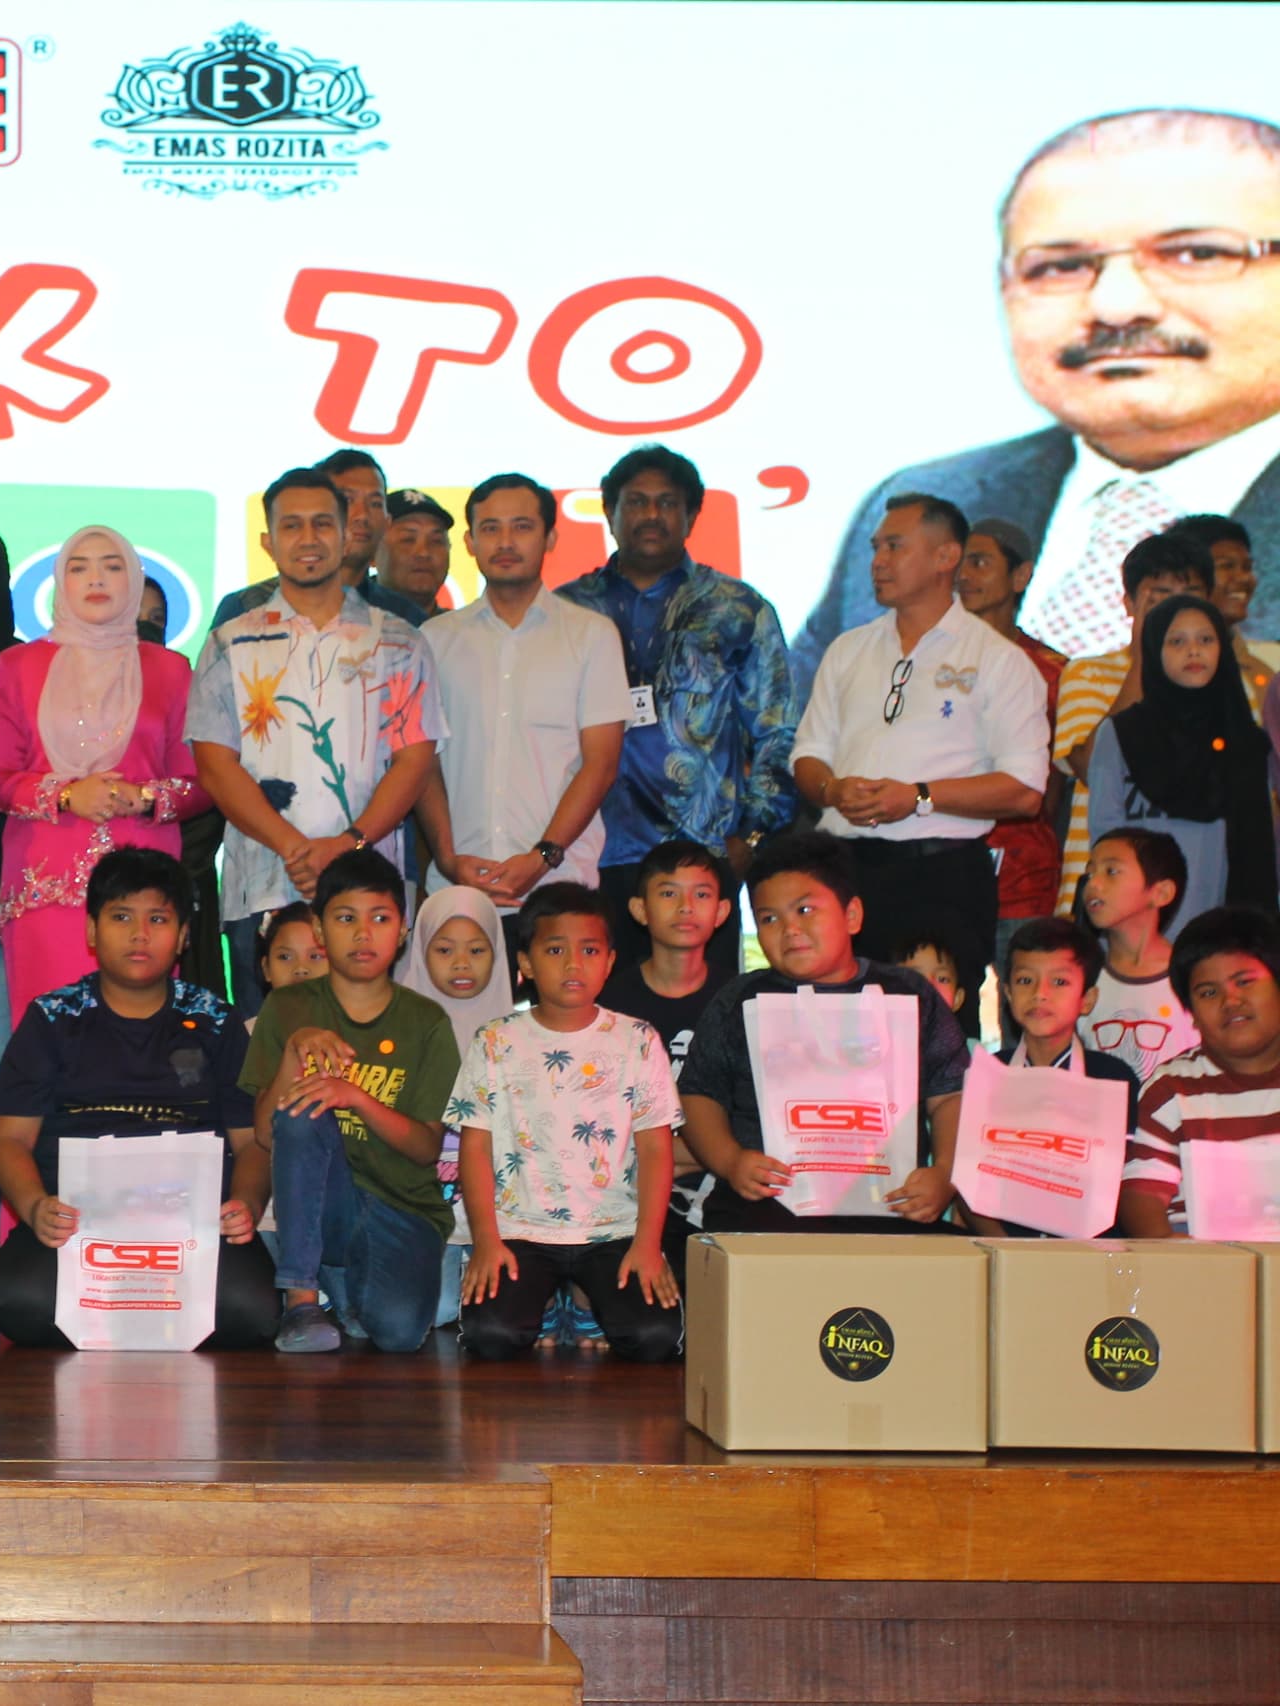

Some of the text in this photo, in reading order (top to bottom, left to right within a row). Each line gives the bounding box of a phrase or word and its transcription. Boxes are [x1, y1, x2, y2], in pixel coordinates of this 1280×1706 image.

[213, 64, 272, 109] ER
[153, 137, 327, 158] EMAS ROZITA
[284, 268, 763, 446] TO
[790, 1105, 883, 1132] CSE
[986, 1129, 1085, 1158] CSE
[85, 1243, 179, 1270] CSE
